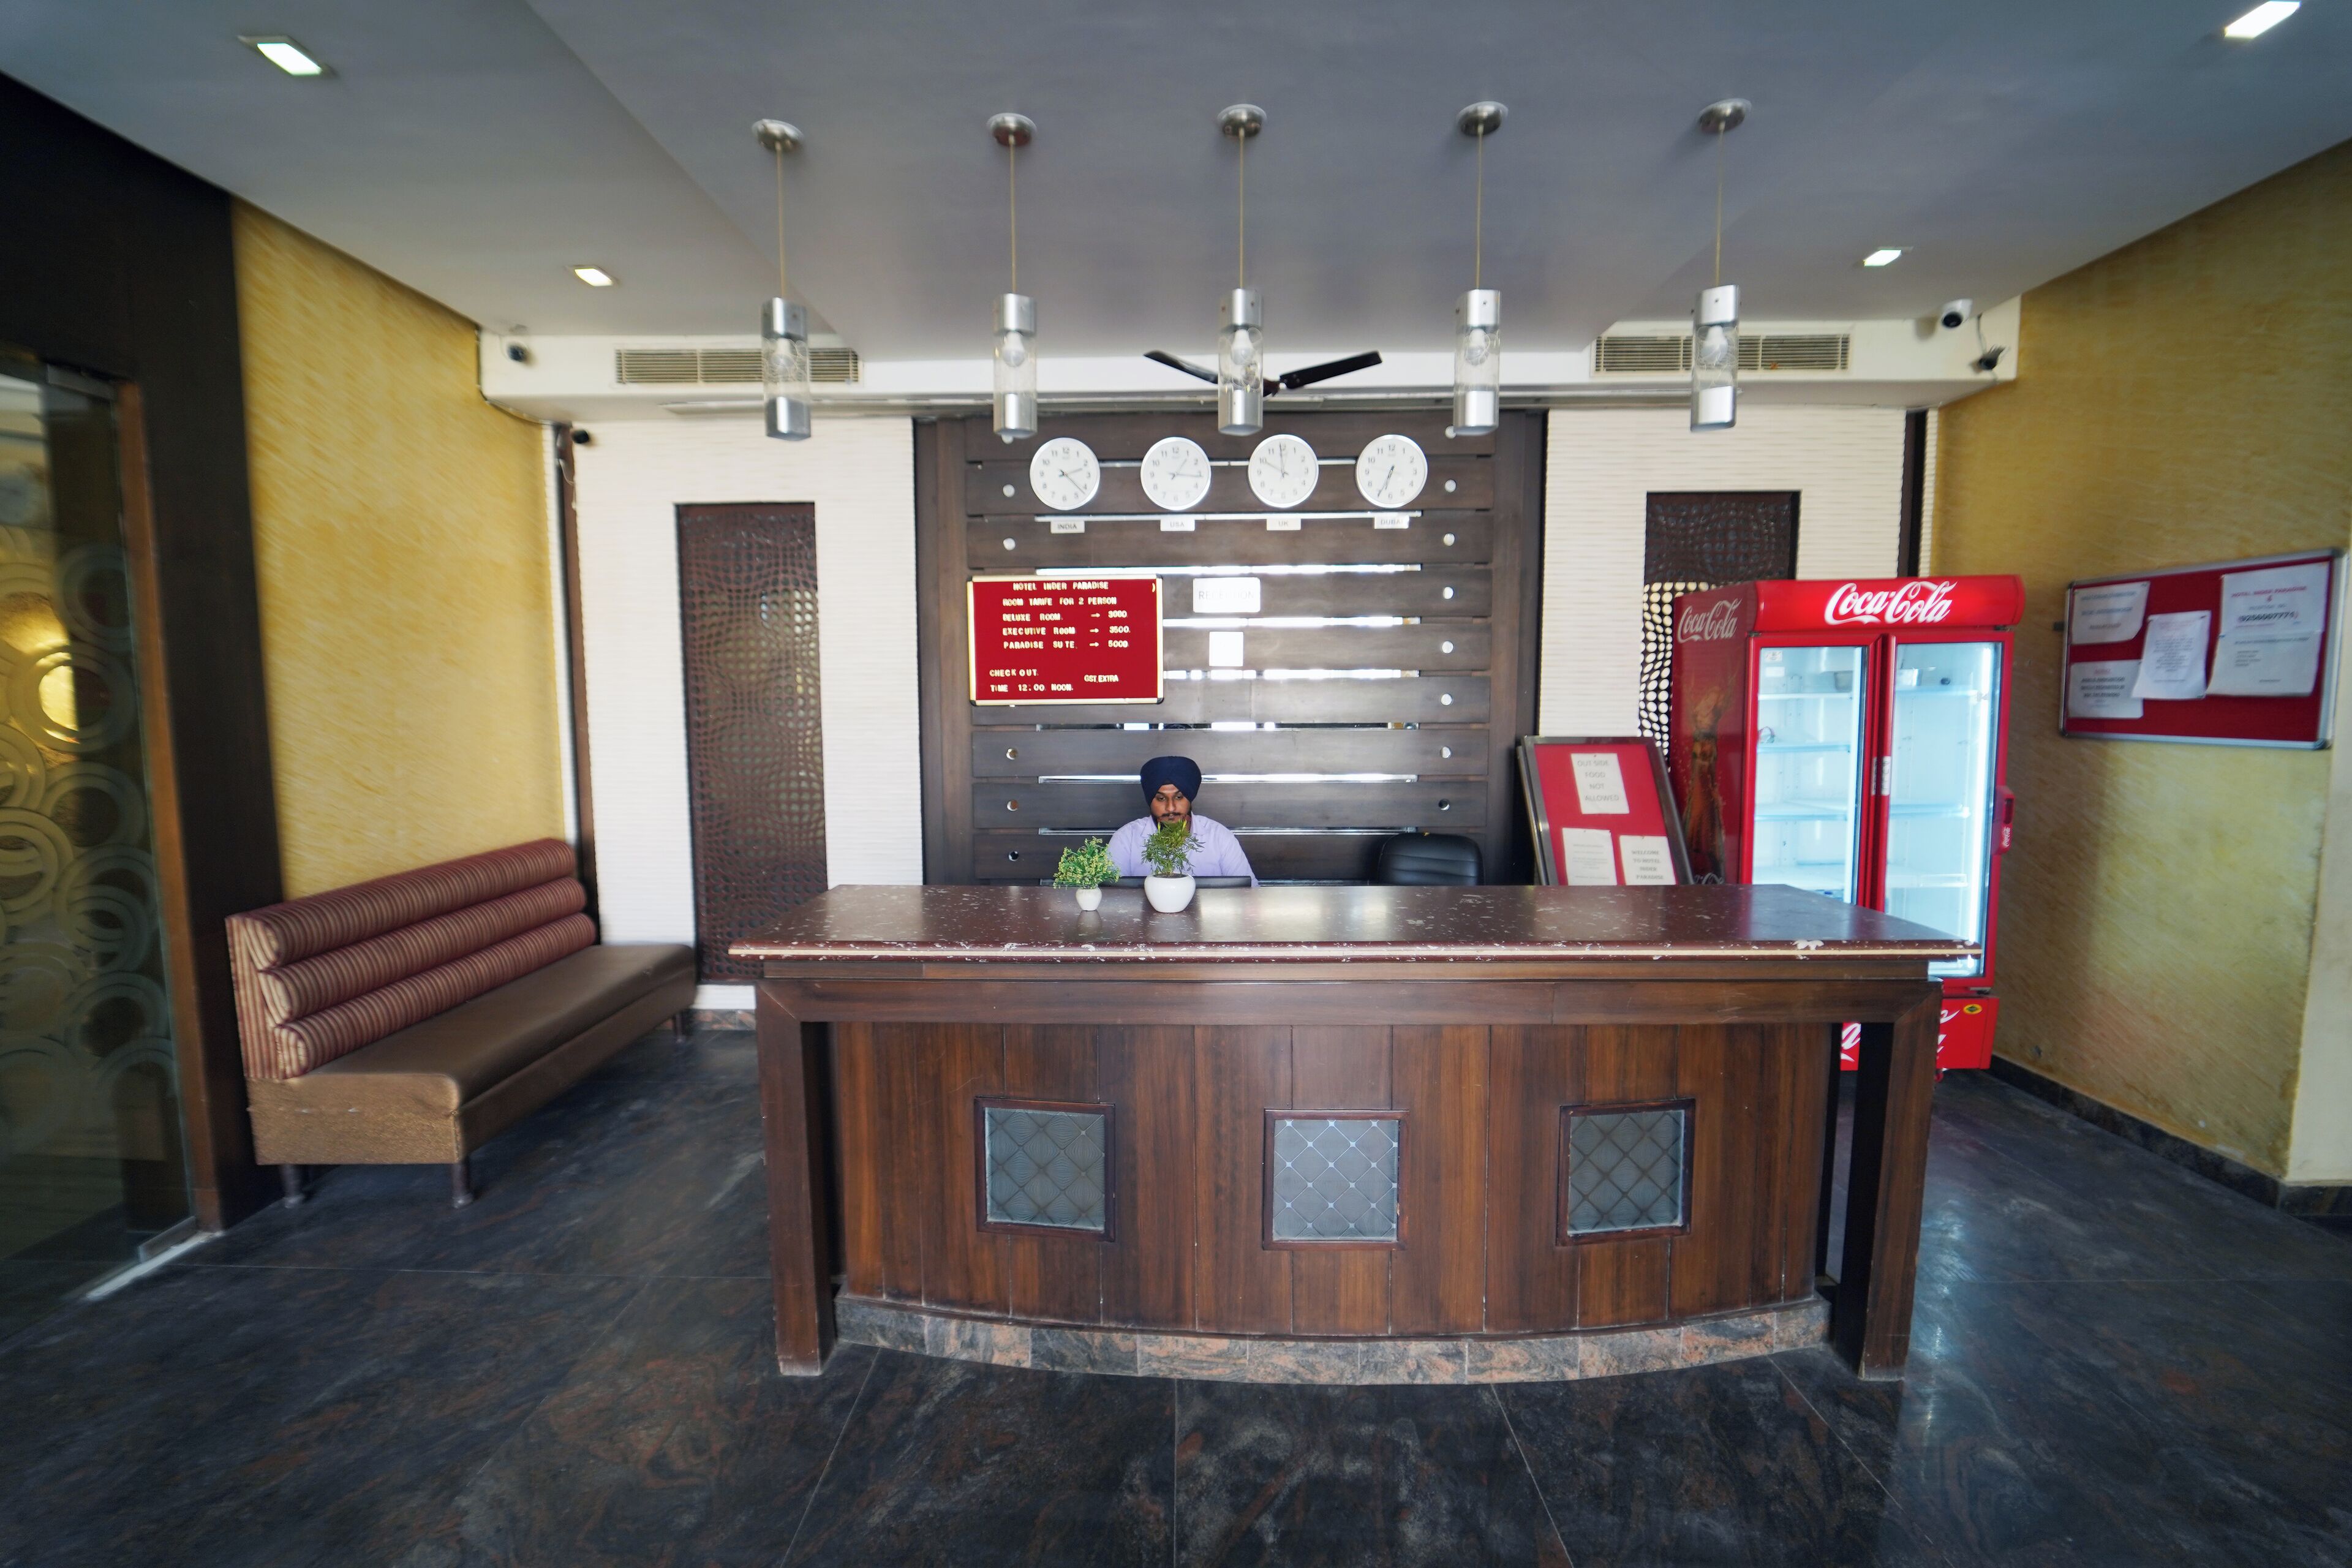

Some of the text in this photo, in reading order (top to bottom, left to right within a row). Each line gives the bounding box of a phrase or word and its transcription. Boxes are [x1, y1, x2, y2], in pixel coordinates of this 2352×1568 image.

[1013, 581, 1109, 591] HOTEL INDER PARADISE
[1002, 598, 1023, 606] ROOM
[1060, 597, 1074, 605] FOR
[1078, 597, 1084, 605] 2
[1087, 597, 1117, 605] PERSON
[1825, 581, 1958, 625] Coca-Cola
[1678, 598, 1741, 643] Coca-Cola
[1002, 627, 1046, 636] EXECUTIVE
[1003, 641, 1044, 649] PARADISE
[989, 669, 1016, 677] CHECK
[990, 684, 1008, 692] TIME
